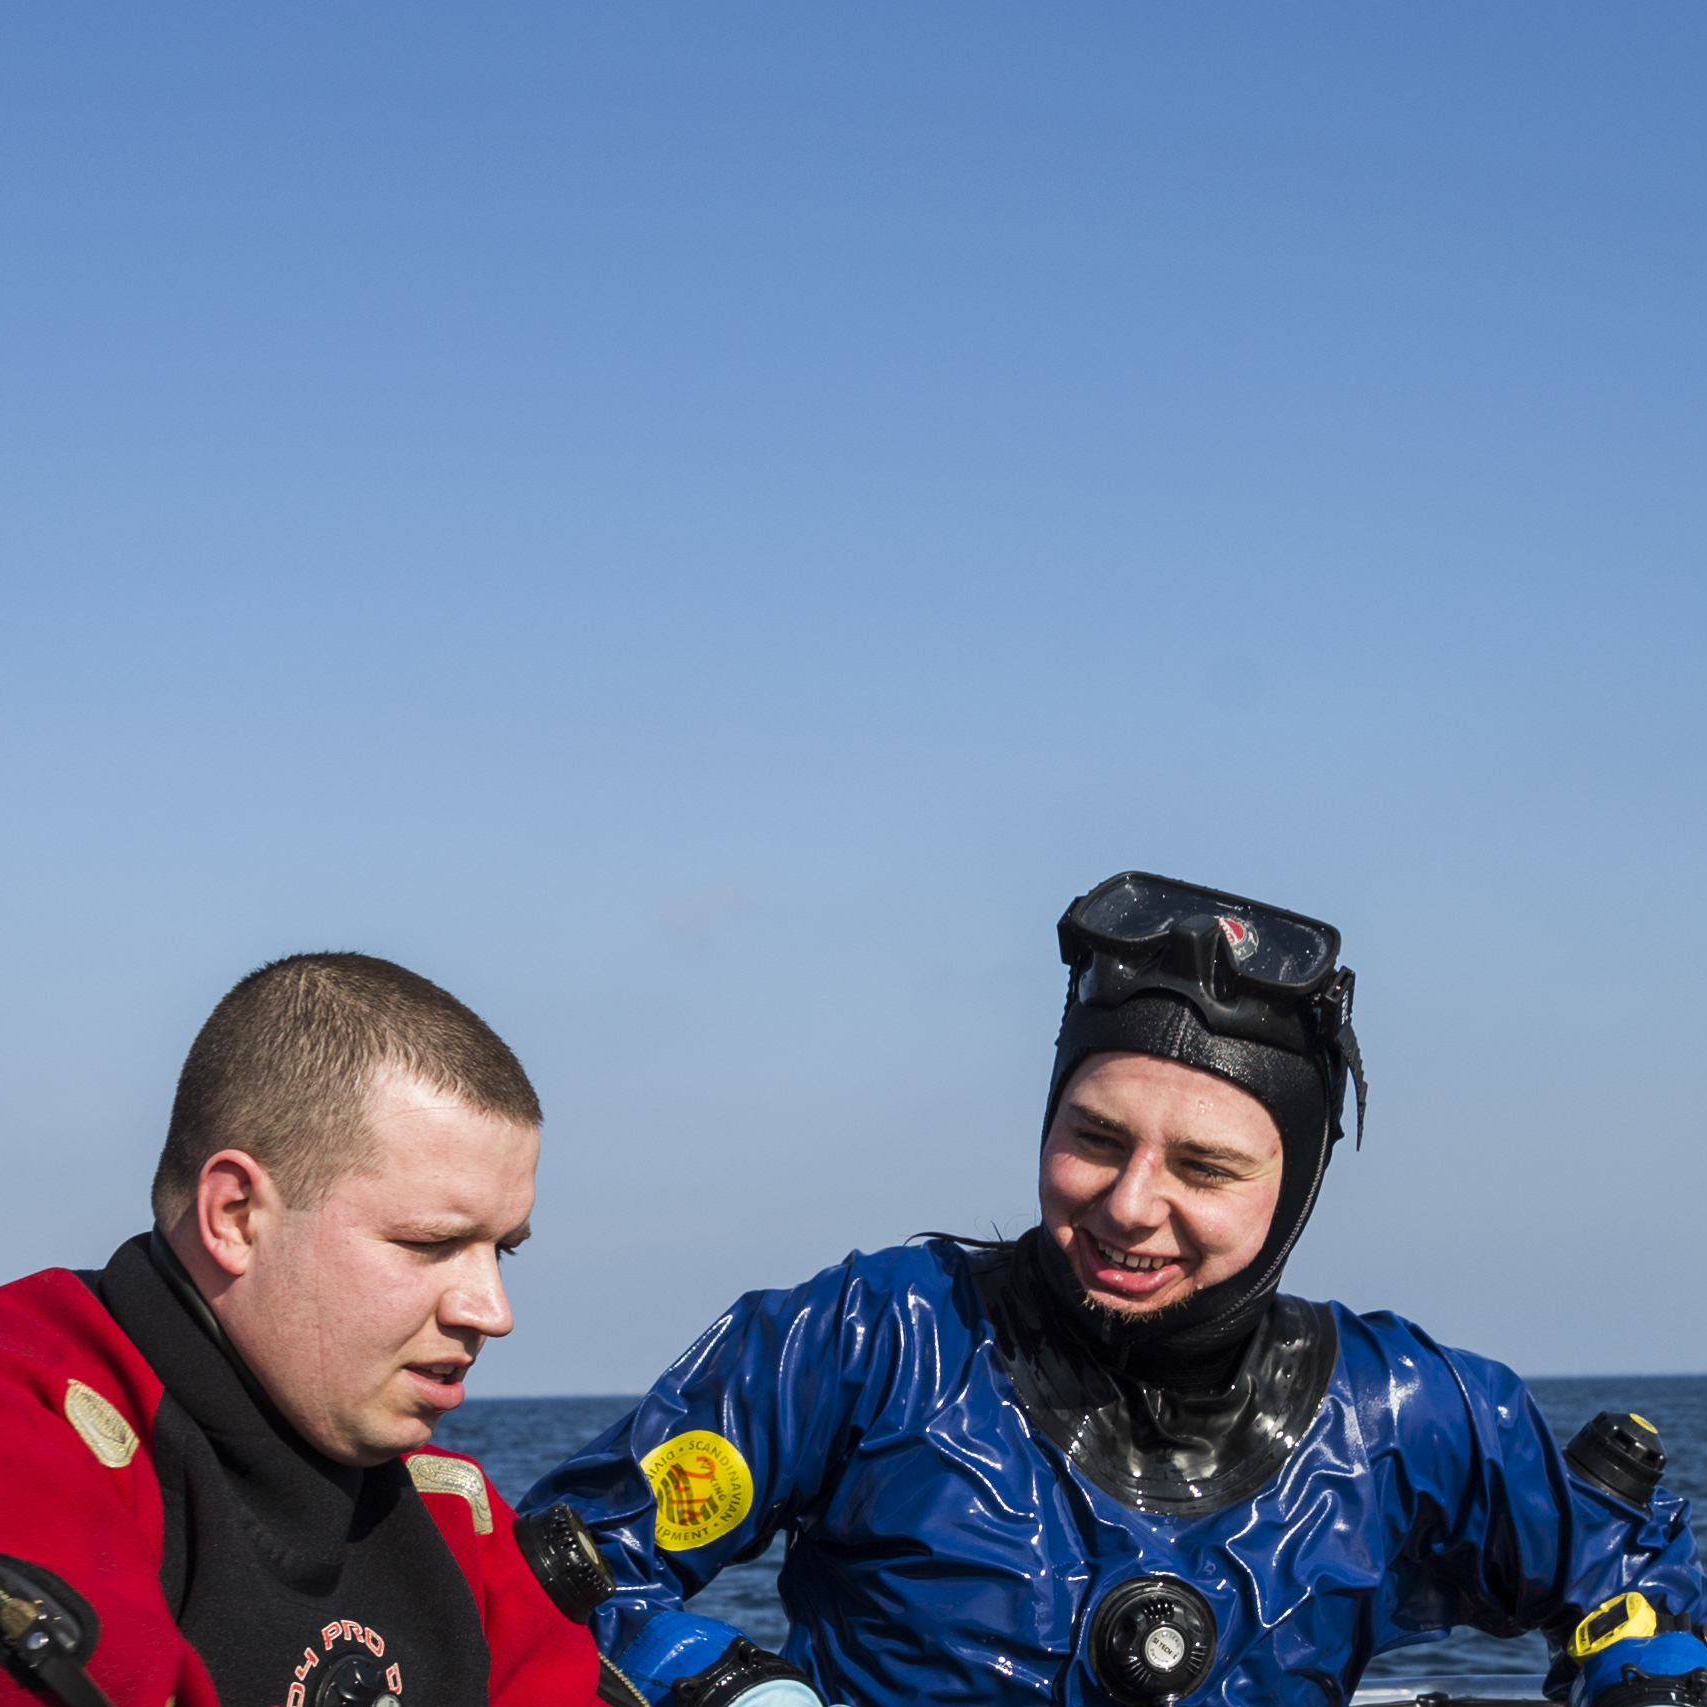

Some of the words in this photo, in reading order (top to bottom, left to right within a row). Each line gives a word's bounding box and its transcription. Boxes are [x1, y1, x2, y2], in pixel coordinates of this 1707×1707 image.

[688, 1440, 742, 1522] SCANDINAVIAN
[655, 1523, 709, 1541] IPMENT
[321, 1619, 386, 1658] PRO
